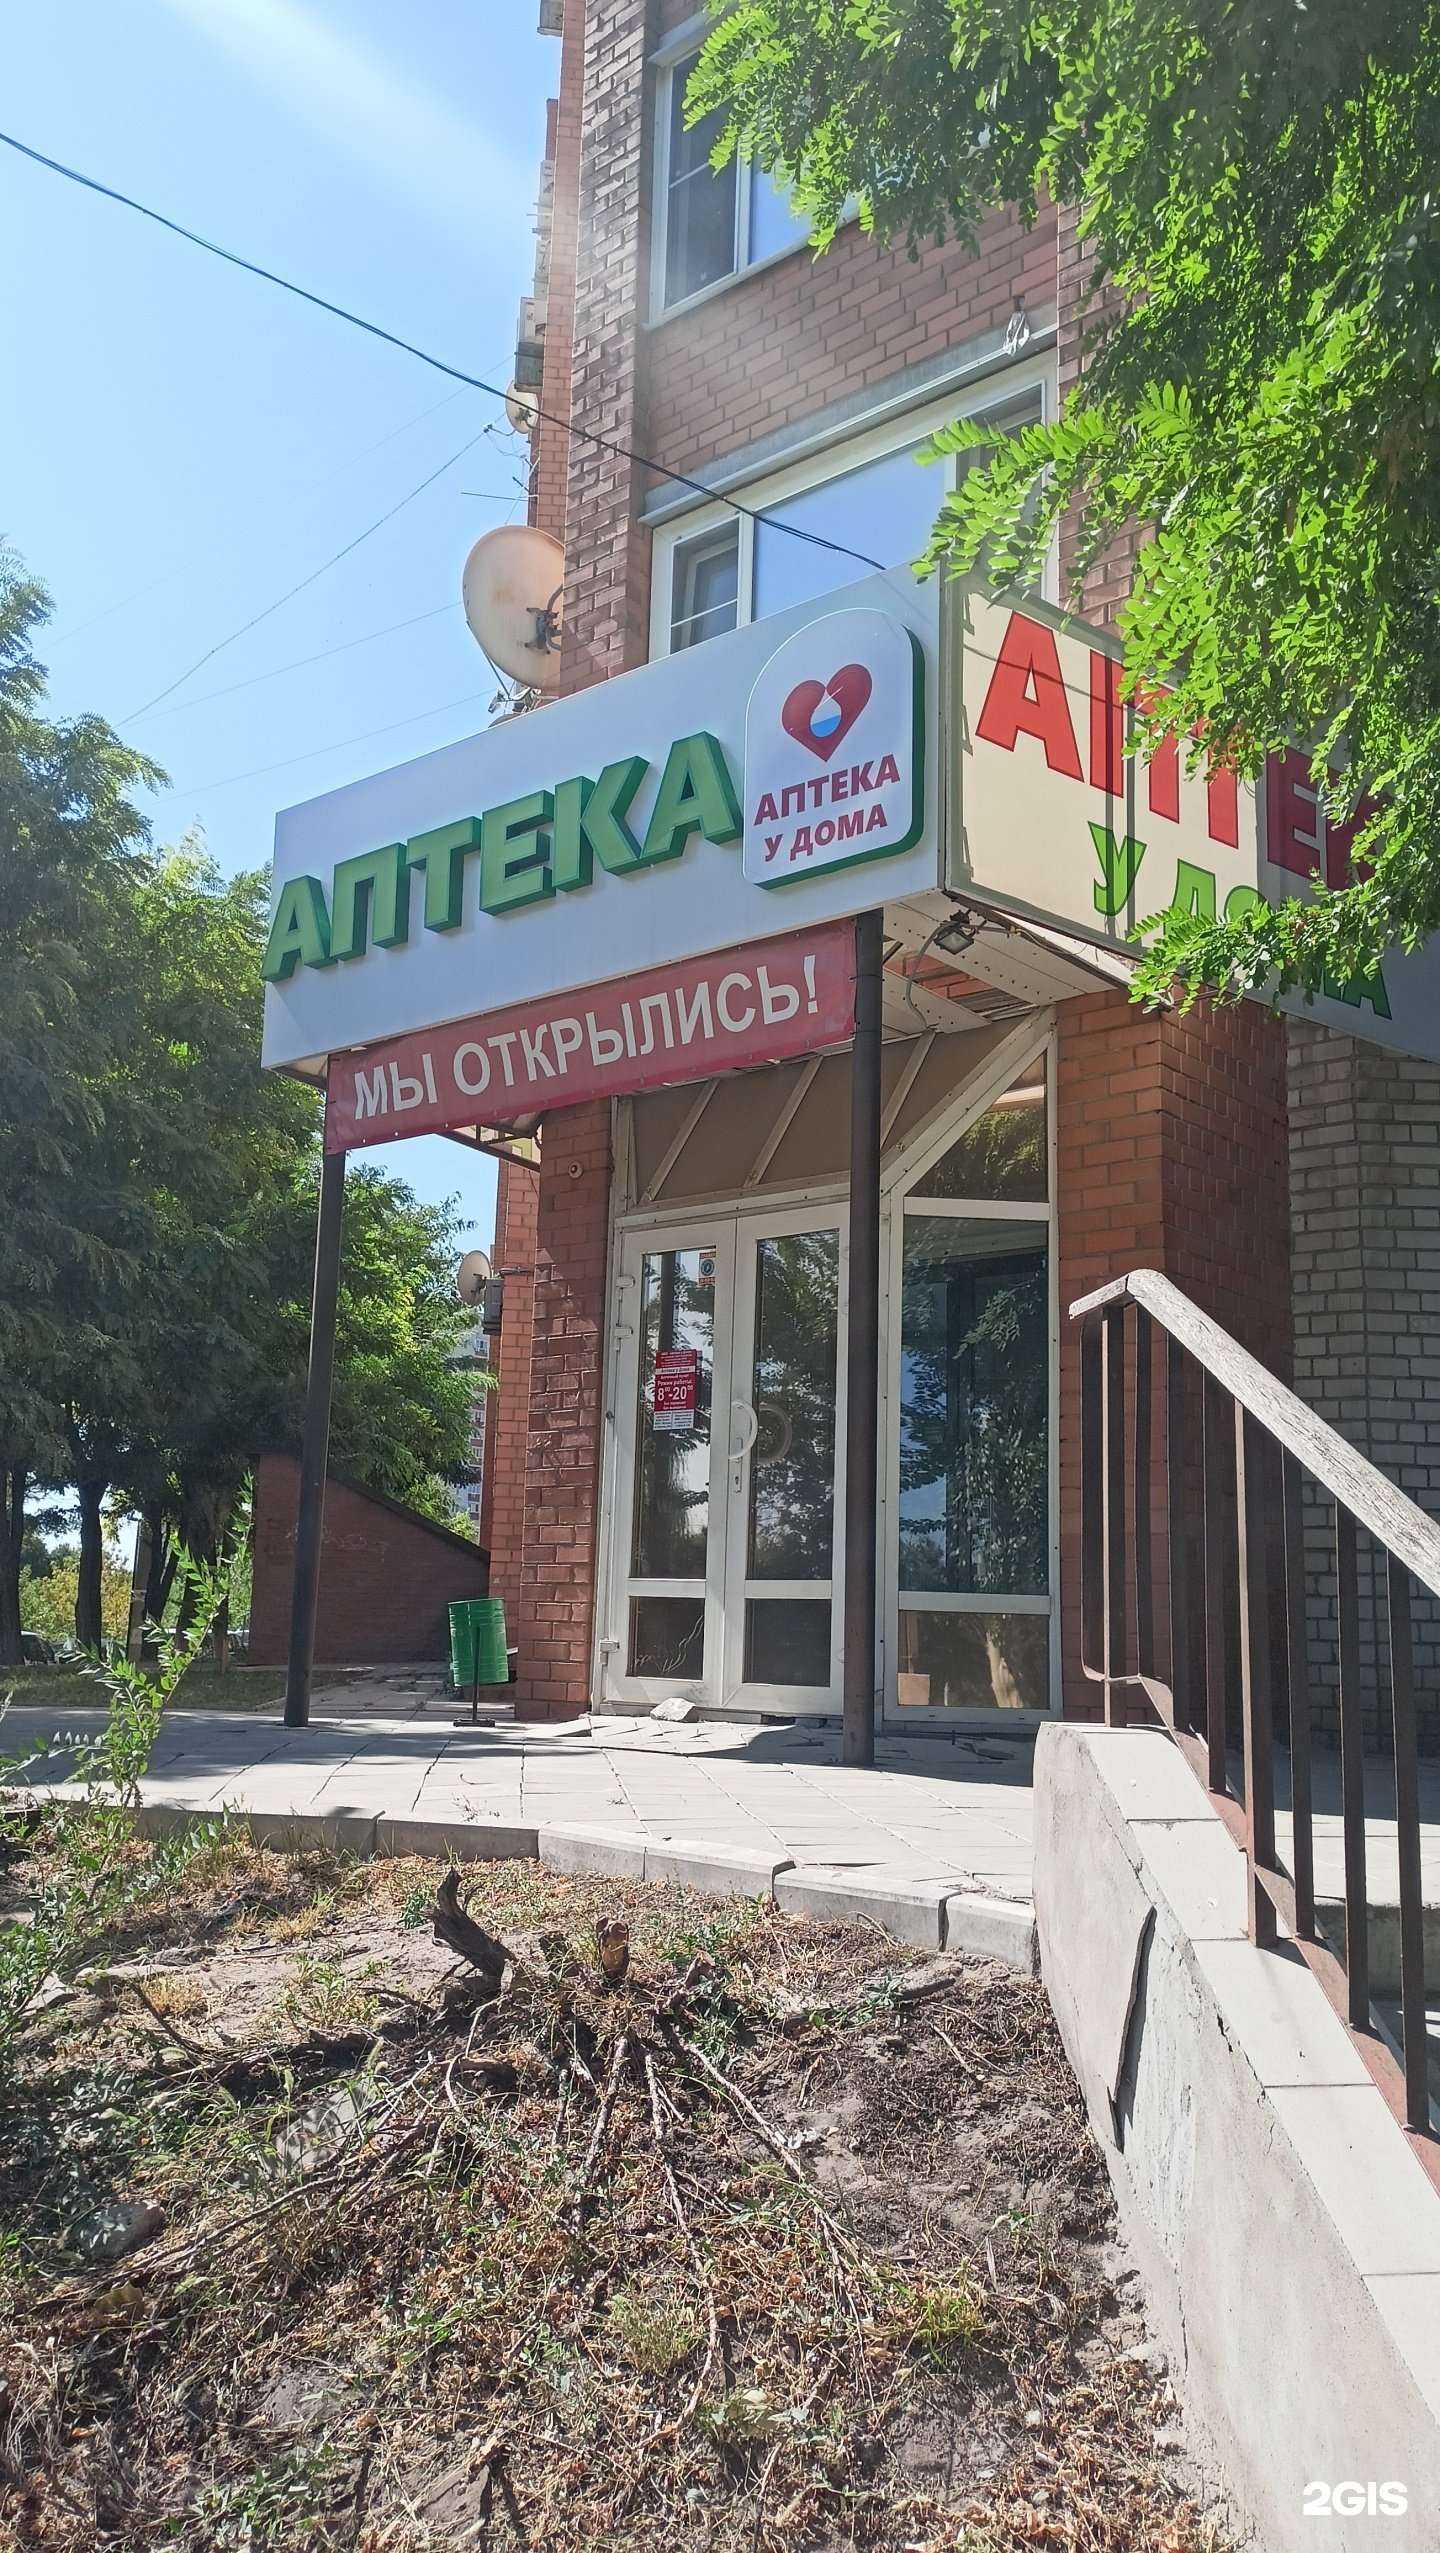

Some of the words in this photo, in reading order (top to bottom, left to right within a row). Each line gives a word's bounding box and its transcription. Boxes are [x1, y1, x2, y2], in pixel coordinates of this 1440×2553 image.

[753, 754, 900, 826] АПТЕКА
[764, 833, 784, 862] У
[789, 803, 888, 861] ДОМА
[260, 731, 744, 982] АПТЕКА
[1087, 821, 1147, 917] У
[354, 1052, 439, 1121] МЫ
[452, 955, 818, 1096] ОТКРЫЛИСЬ!
